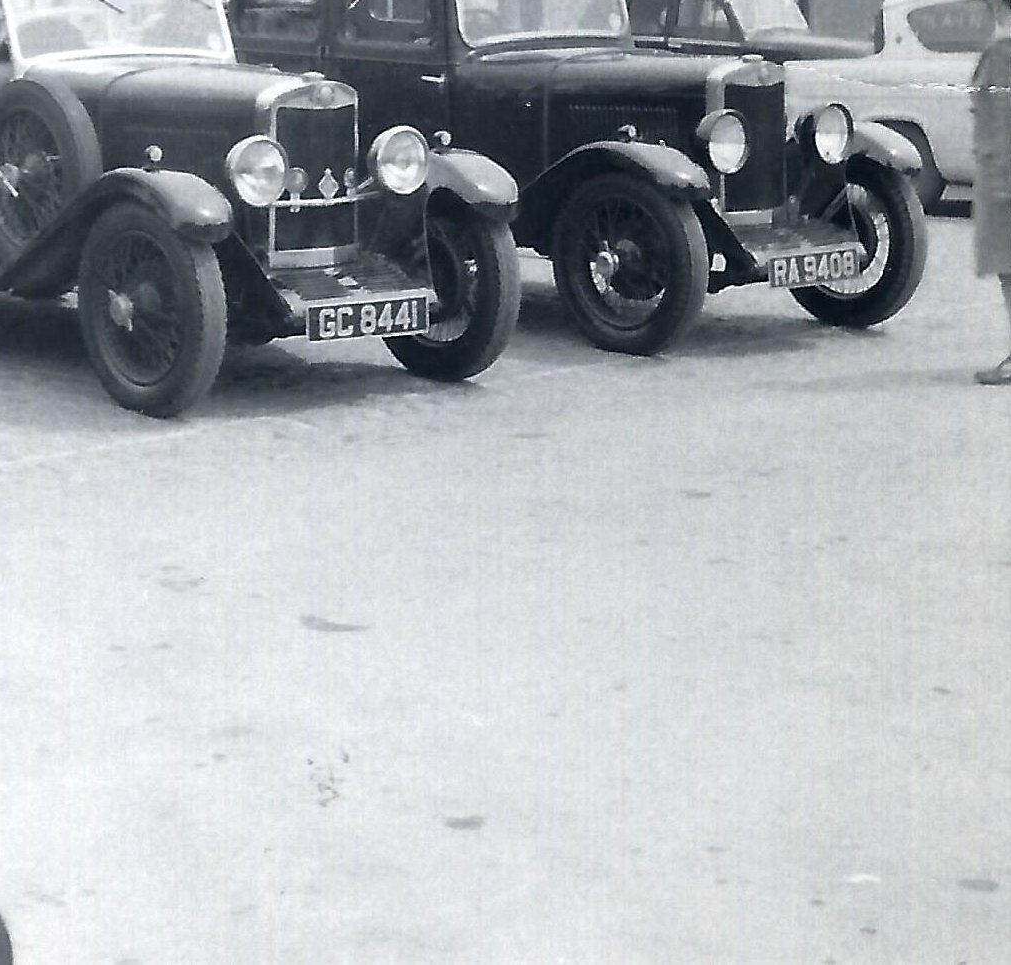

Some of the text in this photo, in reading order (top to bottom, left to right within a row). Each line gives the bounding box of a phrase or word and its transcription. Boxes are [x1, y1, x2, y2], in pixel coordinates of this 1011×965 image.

[774, 251, 856, 285] RA 9408
[319, 300, 419, 338] GC 8441
